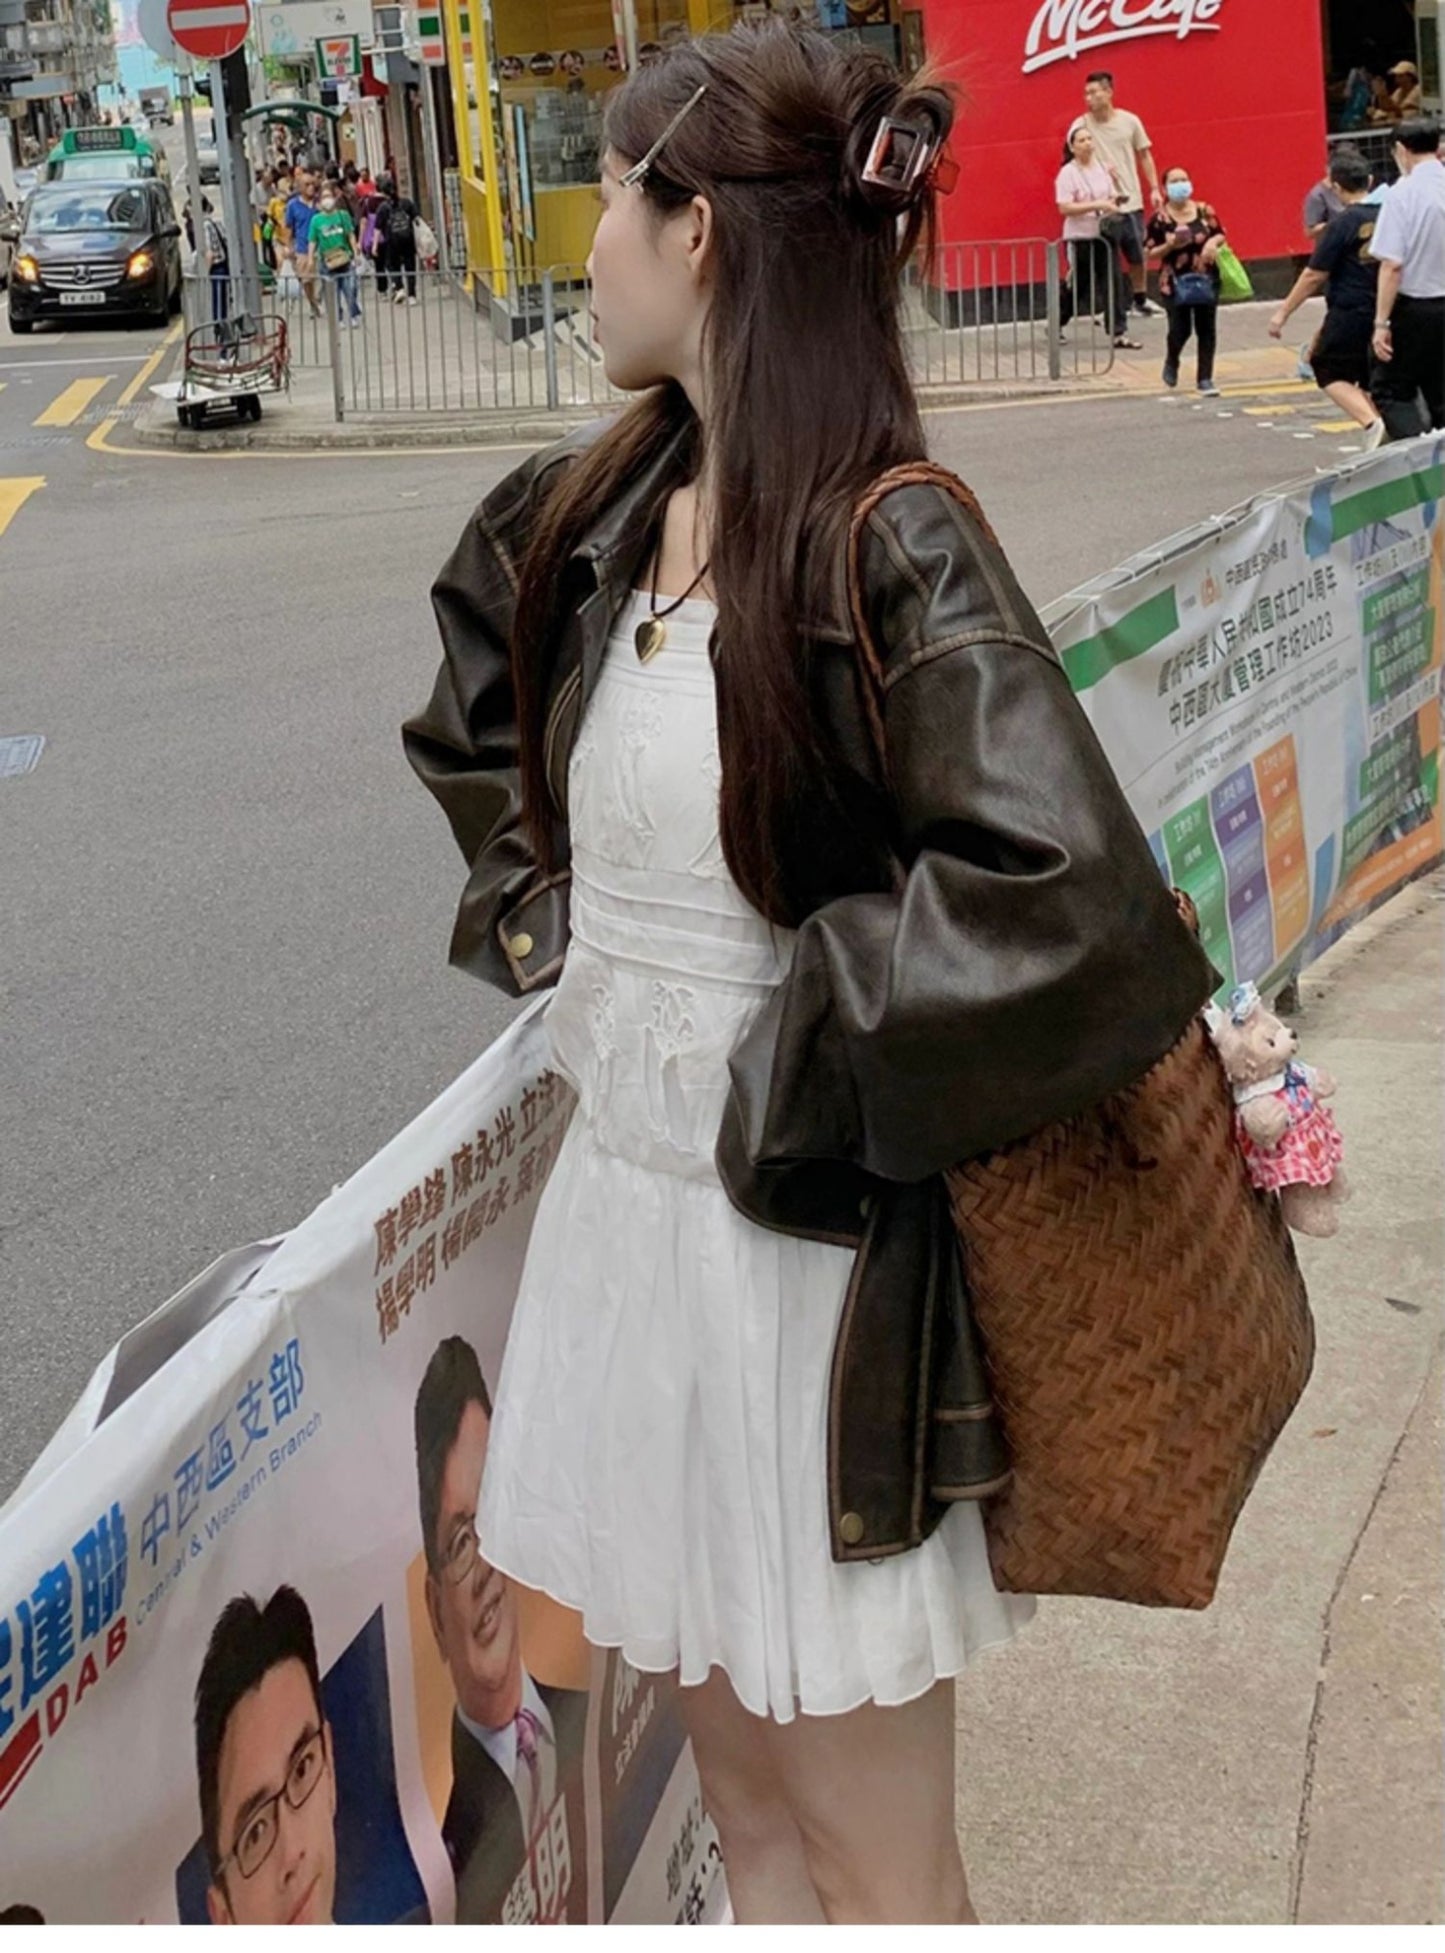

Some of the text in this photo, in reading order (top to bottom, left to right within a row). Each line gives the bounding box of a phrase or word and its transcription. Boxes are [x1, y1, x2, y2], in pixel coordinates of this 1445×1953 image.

[136, 1411, 323, 1626] Central & Western Branch
[140, 1338, 304, 1566] 中西區支部
[46, 1616, 127, 1738] DAB
